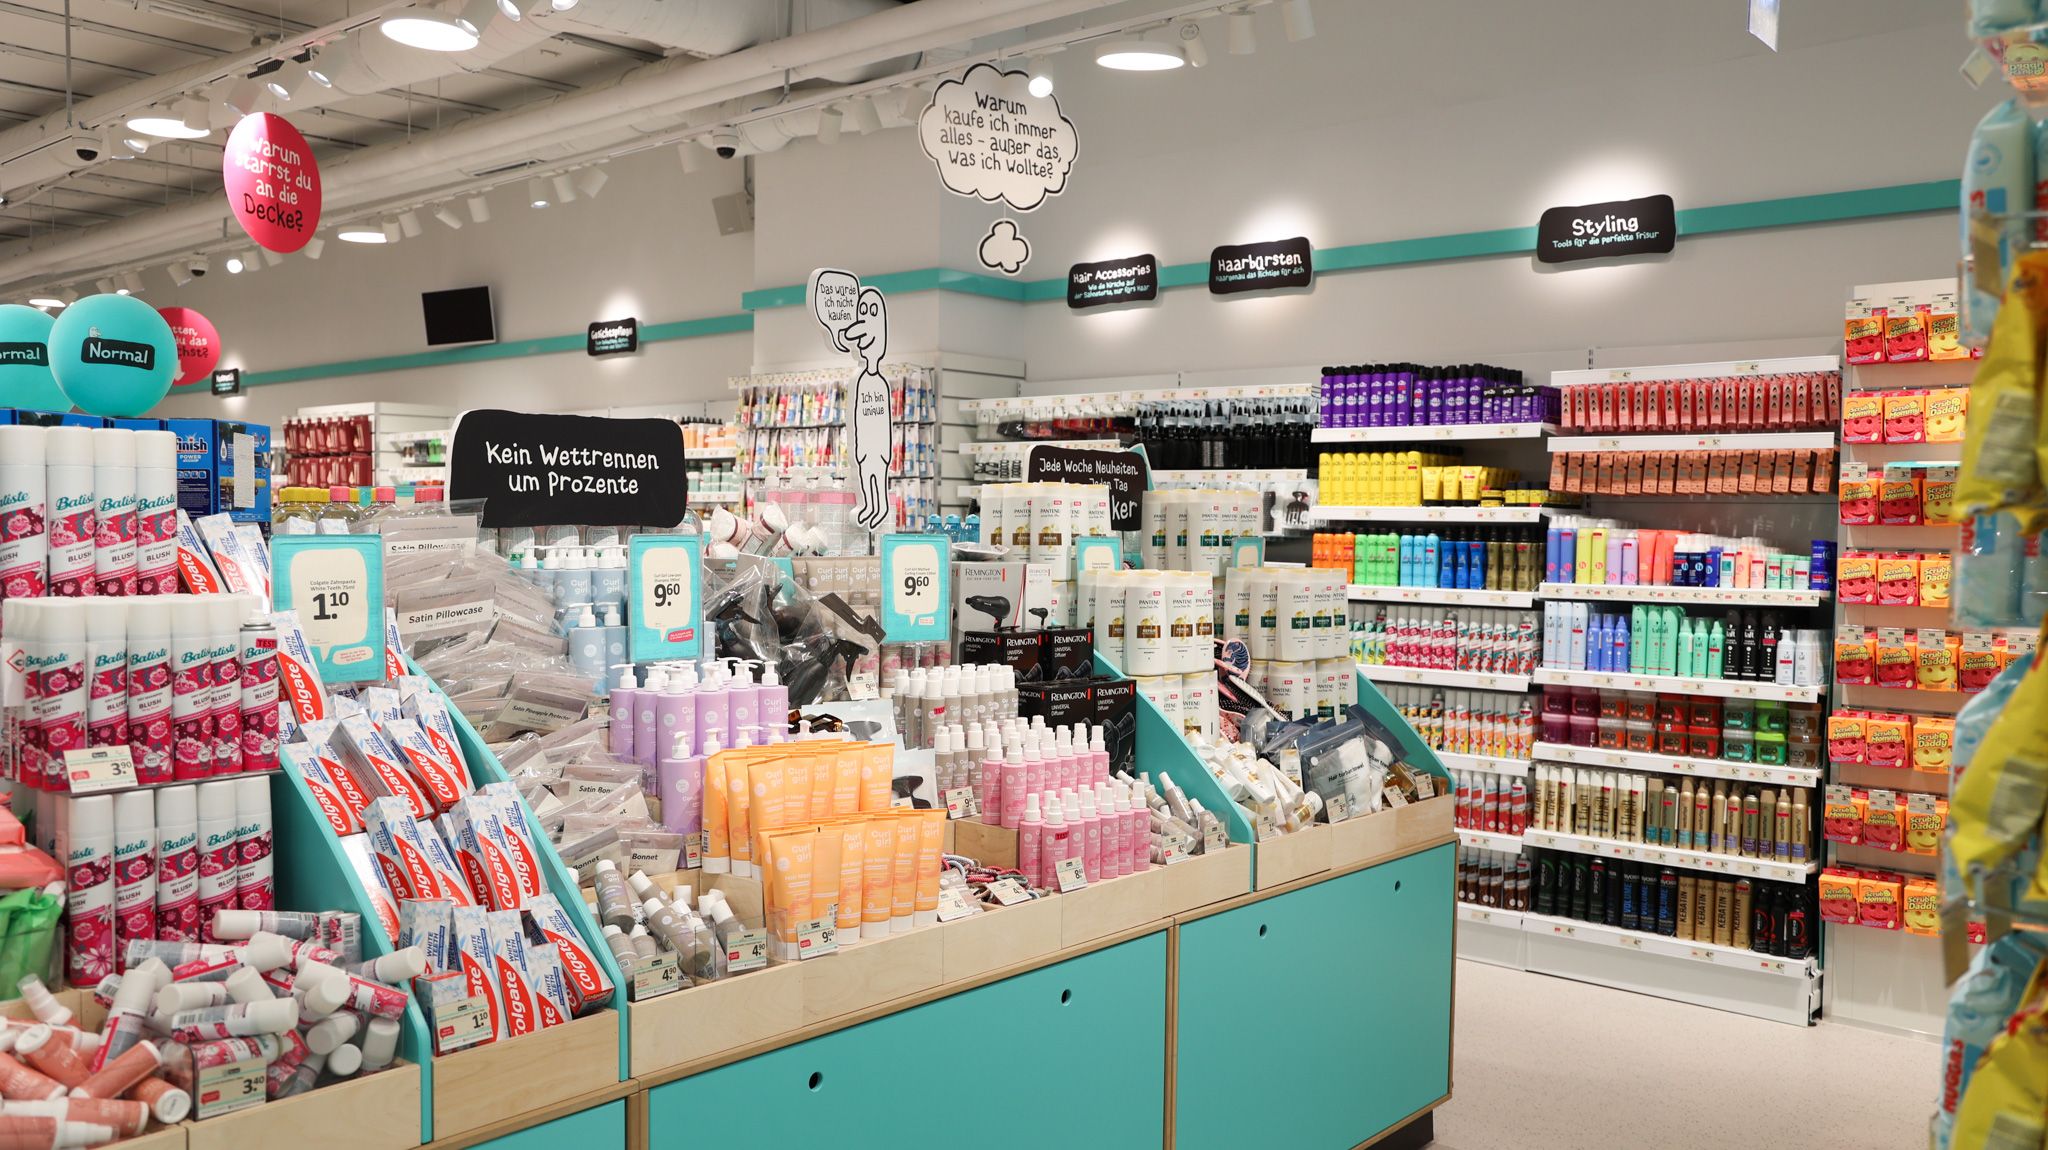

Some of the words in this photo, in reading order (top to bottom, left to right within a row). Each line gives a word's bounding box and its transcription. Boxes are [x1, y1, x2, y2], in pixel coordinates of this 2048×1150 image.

[975, 91, 1027, 115] Warum
[944, 105, 984, 128] kaufe
[989, 114, 1009, 132] ich
[1014, 118, 1056, 139] immer
[940, 128, 973, 145] alles
[981, 153, 1001, 170] ich
[296, 170, 312, 191] du
[255, 179, 274, 198] an
[279, 184, 298, 205] die
[243, 193, 304, 232] Decke?
[1571, 214, 1639, 236] Styling
[1552, 237, 1572, 248] Tools
[1589, 235, 1600, 245] die
[1601, 232, 1634, 245] perfekte
[1073, 272, 1093, 284] Hair
[1095, 265, 1151, 280] Accessories
[820, 283, 833, 295] Das
[824, 297, 834, 308] ich
[836, 298, 854, 308] nicht
[828, 310, 852, 321] kaufen
[0, 347, 40, 360] rmal
[89, 341, 149, 364] Normal
[861, 393, 873, 404] Ich
[874, 392, 884, 402] bin
[862, 406, 884, 417] unique
[1930, 404, 1960, 416] Daddy
[176, 436, 207, 450] finish
[485, 441, 533, 466] Kein
[539, 444, 660, 470] Wettrennen
[1039, 458, 1061, 473] Jede
[1064, 458, 1093, 473] Woche
[508, 473, 540, 492] um
[1113, 478, 1128, 492] Tag
[56, 492, 95, 511] Batist
[68, 552, 92, 563] BLUSH
[146, 551, 171, 562] BLUSH
[965, 568, 1001, 577] REMINGTON
[570, 579, 588, 587] Curl
[574, 587, 588, 595] girl
[409, 613, 433, 624] Satin
[436, 605, 483, 619] Pillowcase
[965, 635, 996, 644] REMINGTON
[1007, 637, 1038, 647] REMINGTON
[1054, 635, 1087, 644] REMINGTON
[130, 648, 167, 665] Batiste
[1921, 656, 1951, 666] Daddy
[255, 690, 274, 700] BLUSH
[1051, 692, 1087, 701] REMINGTON
[1097, 687, 1129, 697] REMINGTON
[139, 698, 162, 709] BLUSH
[1919, 738, 1948, 748] Daddy
[578, 785, 596, 793] Satin
[312, 785, 347, 832] Colgate
[1911, 820, 1941, 831] Daddy
[632, 853, 658, 861] Bonnet
[488, 846, 515, 909] Colgate
[172, 882, 193, 895] BLUSH
[1698, 893, 1706, 926] KERATIN
[1718, 896, 1727, 929] KERATIN
[557, 937, 596, 991] Colgate
